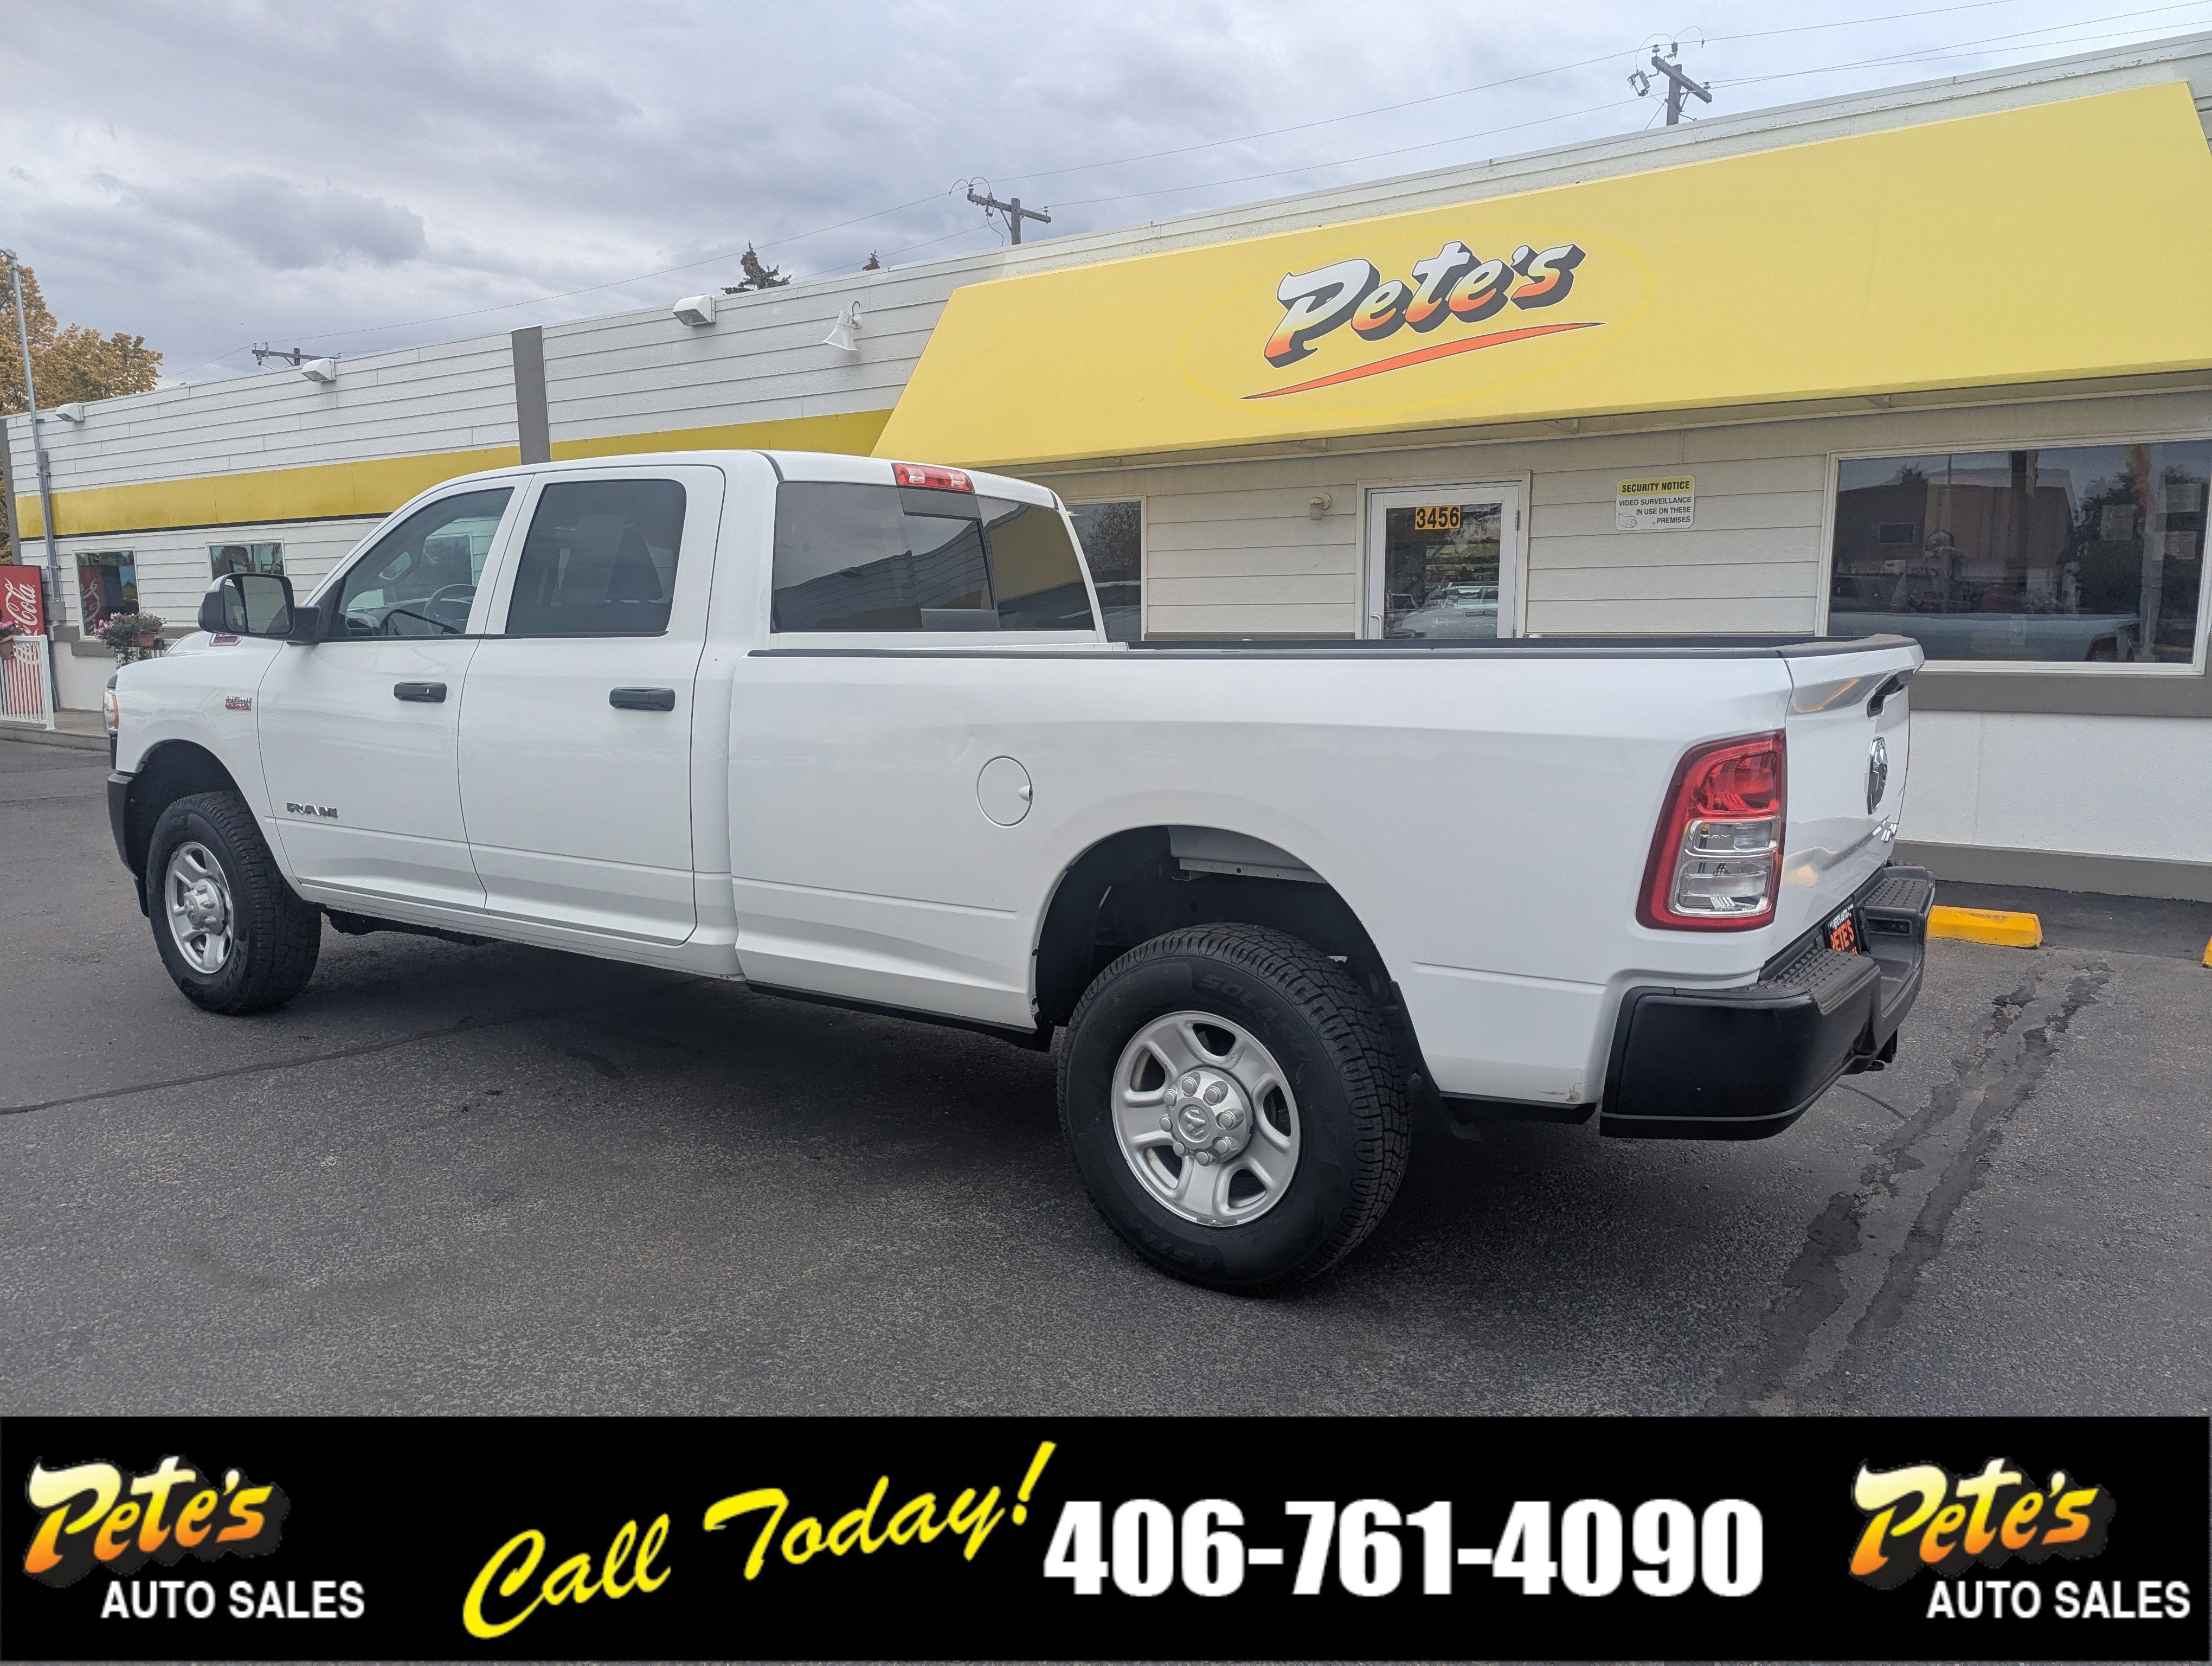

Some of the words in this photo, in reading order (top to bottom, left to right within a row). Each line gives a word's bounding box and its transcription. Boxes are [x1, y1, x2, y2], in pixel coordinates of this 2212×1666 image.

[1264, 241, 1586, 368] Pete's
[1622, 483, 1658, 492] SECURITY
[1662, 481, 1690, 490] NOTICE
[1641, 496, 1692, 505] SURVEILLANCE
[1417, 507, 1459, 528] 3456
[286, 802, 338, 818] RAM
